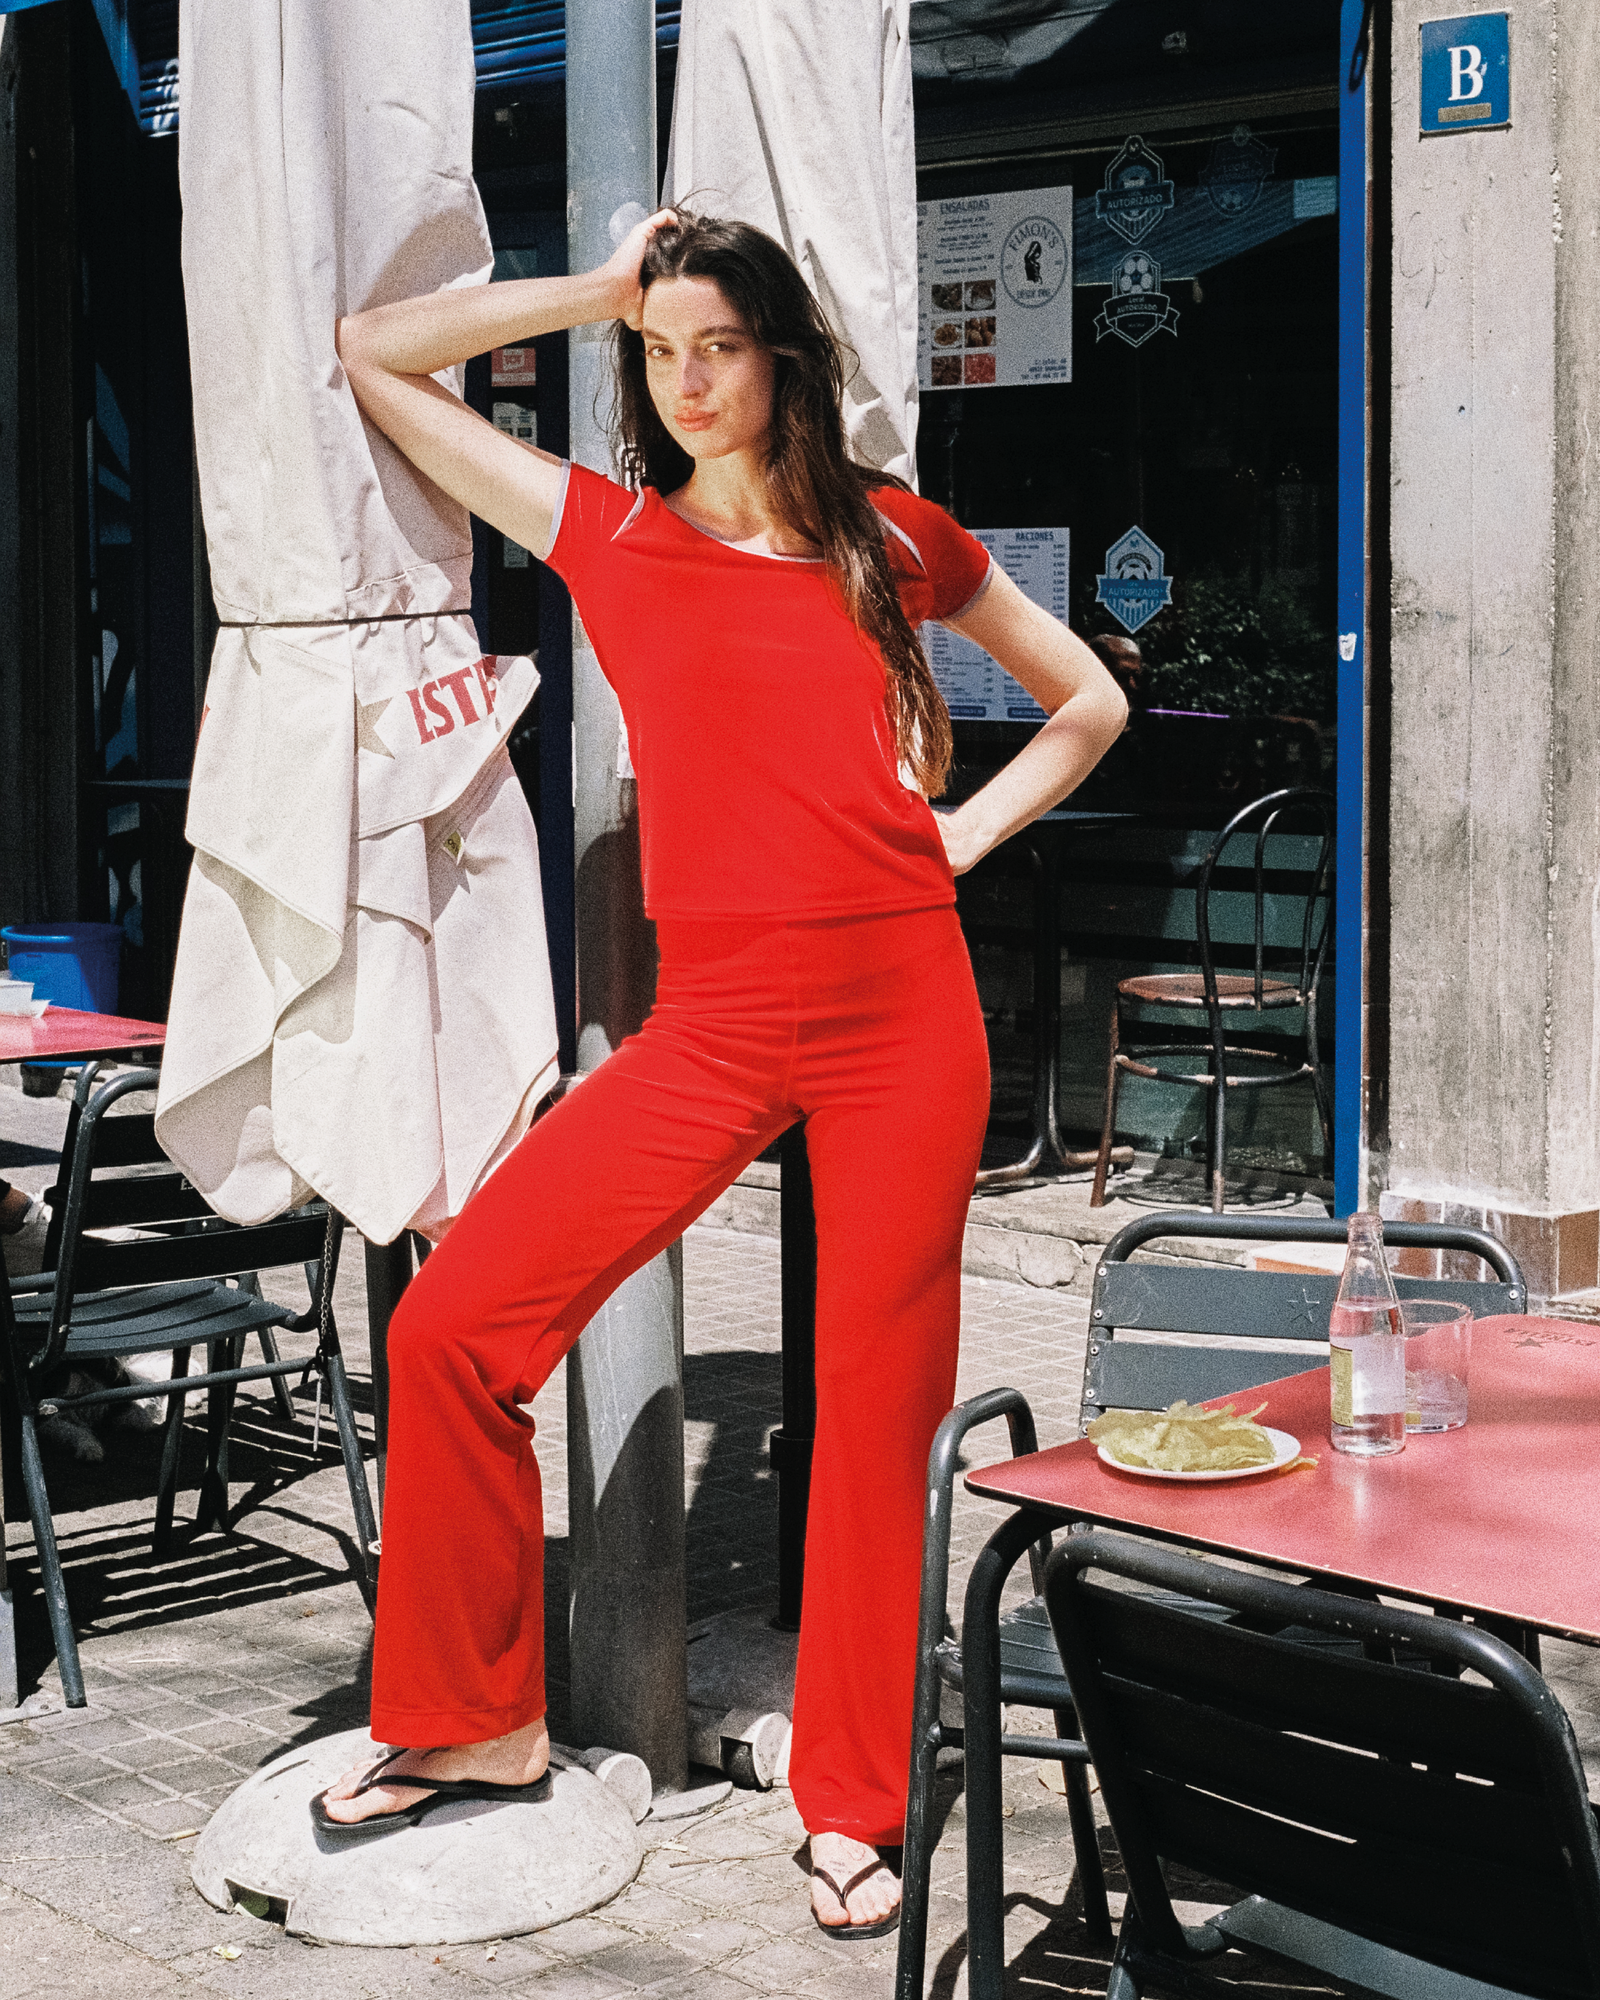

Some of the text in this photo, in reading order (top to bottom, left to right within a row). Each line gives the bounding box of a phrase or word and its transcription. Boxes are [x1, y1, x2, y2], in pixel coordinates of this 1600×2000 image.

[1447, 45, 1484, 101] B
[940, 198, 990, 215] ENSALADAS
[1107, 193, 1163, 209] AUTORIZADO
[1116, 303, 1158, 314] AUTORIZADO
[1015, 531, 1054, 542] RACIONES
[1108, 587, 1160, 597] AUTORIZADO
